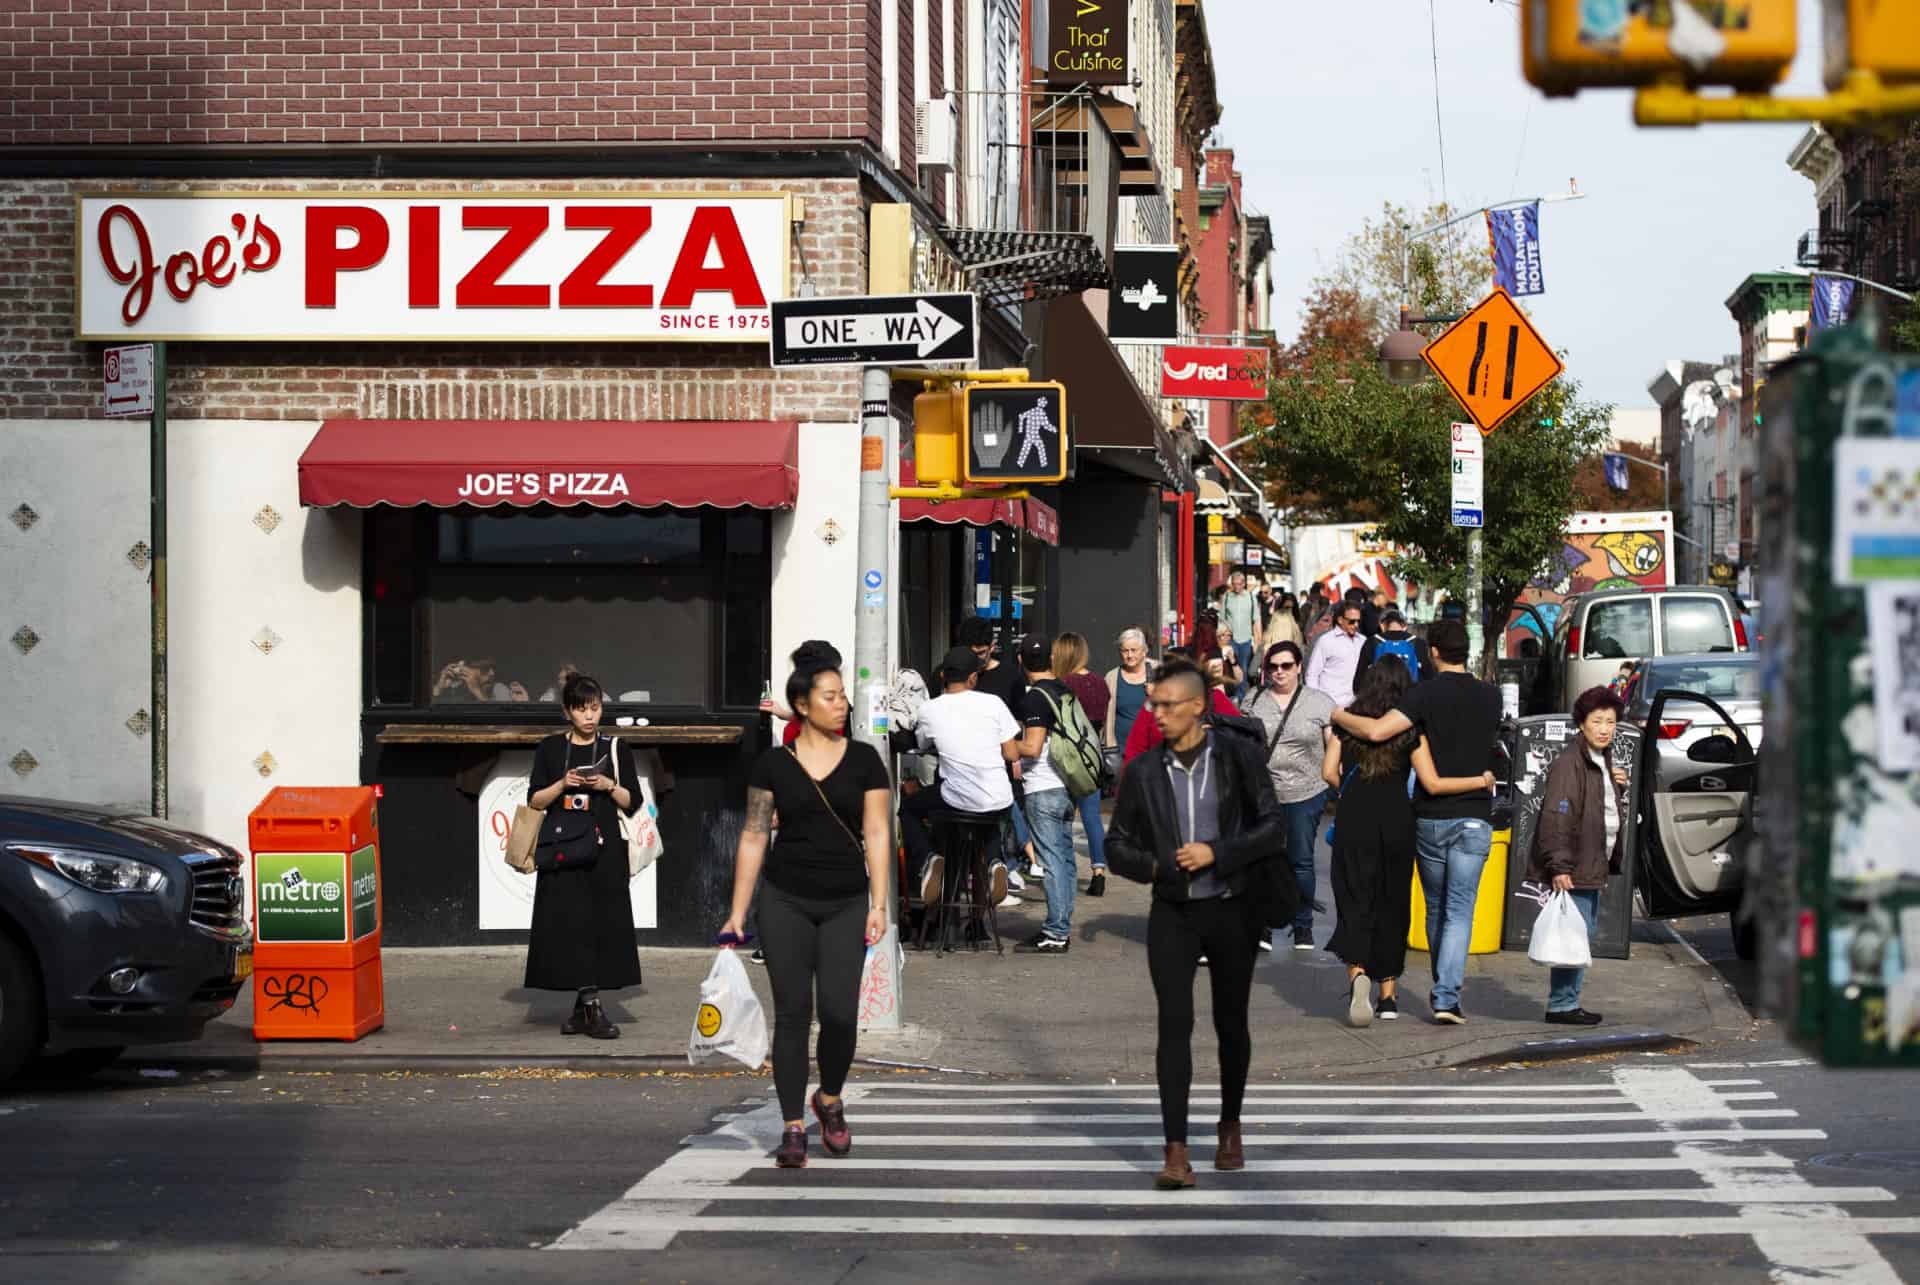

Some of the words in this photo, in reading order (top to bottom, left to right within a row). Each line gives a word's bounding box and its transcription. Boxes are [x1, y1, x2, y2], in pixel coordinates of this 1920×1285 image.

[1067, 26, 1110, 47] Thai
[1054, 50, 1123, 71] Cuisine
[1512, 208, 1528, 294] MARATHON
[97, 203, 282, 326] Joe's
[305, 205, 767, 309] PIZZA
[1527, 240, 1540, 293] ROUTE
[660, 314, 719, 329] SINCE
[728, 314, 770, 329] 1975
[801, 319, 857, 344] ONE
[885, 316, 943, 342] WAY
[458, 473, 541, 496] JOE'S
[548, 473, 629, 496] PIZZA
[262, 879, 340, 902] metro
[353, 872, 376, 897] metro
